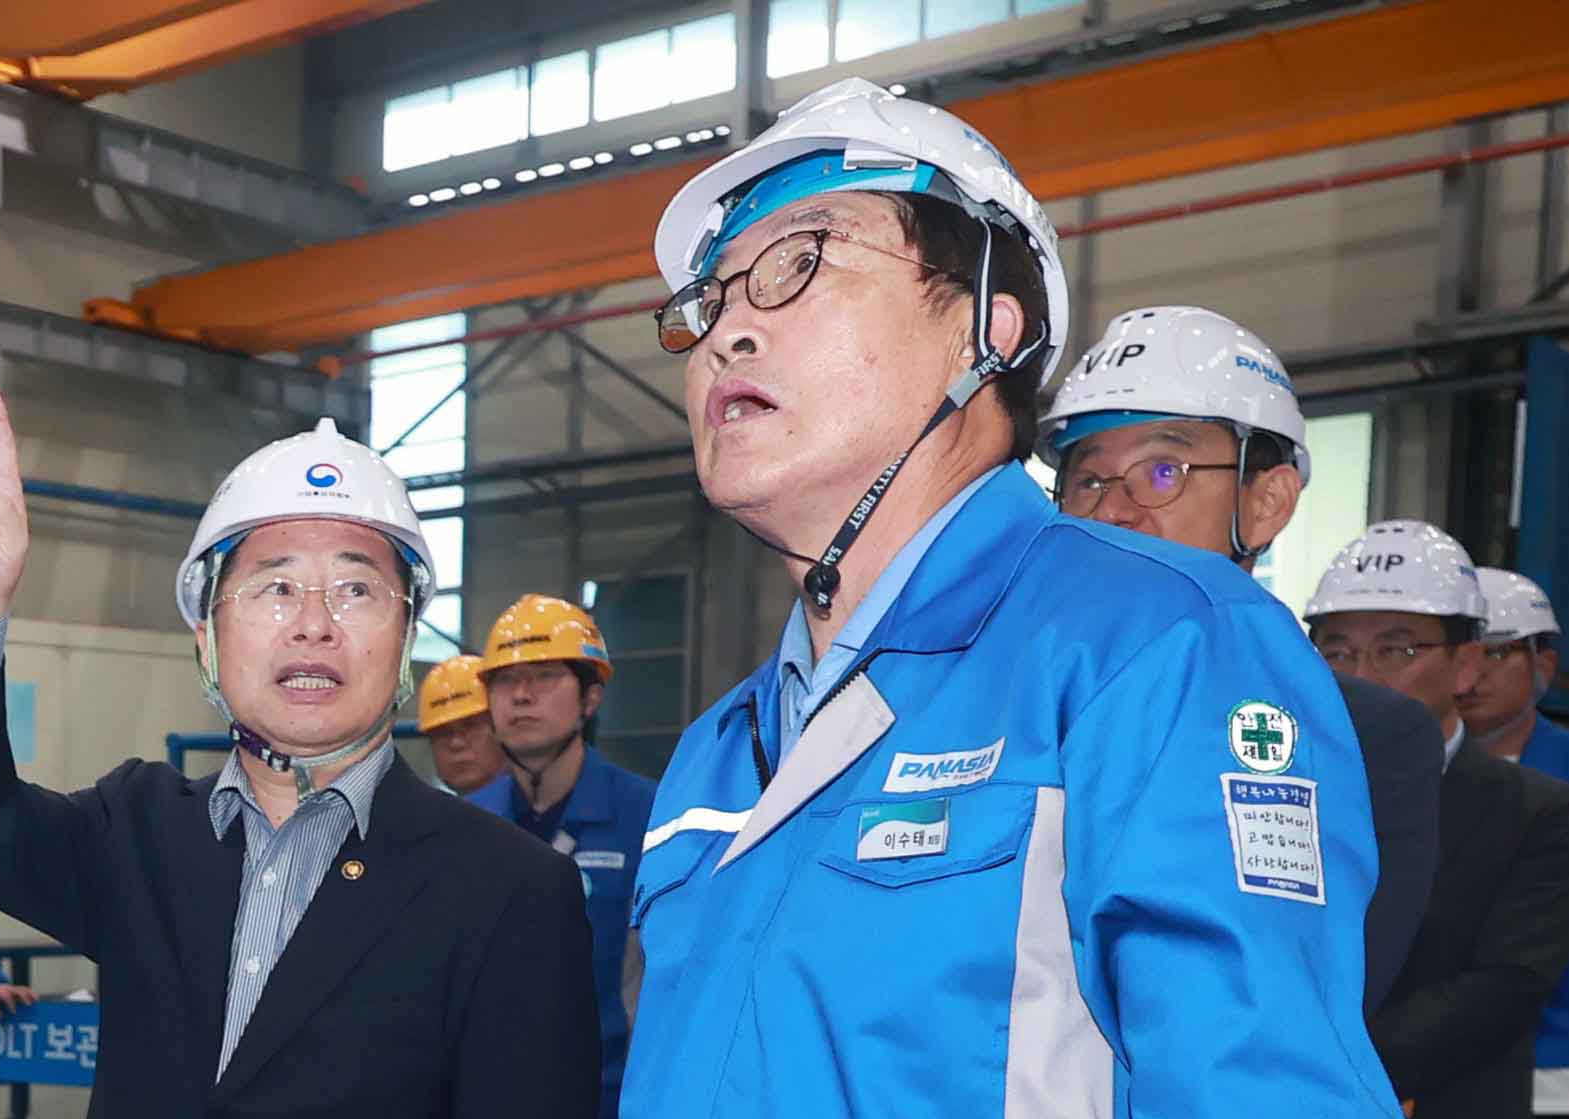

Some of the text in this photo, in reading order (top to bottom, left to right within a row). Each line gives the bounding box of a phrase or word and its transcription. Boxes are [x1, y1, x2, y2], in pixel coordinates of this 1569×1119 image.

[1085, 343, 1146, 375] VIP
[848, 493, 877, 530] FIRST
[1356, 553, 1405, 573] VIP
[897, 750, 994, 780] PANASIA
[883, 830, 926, 850] 이수태
